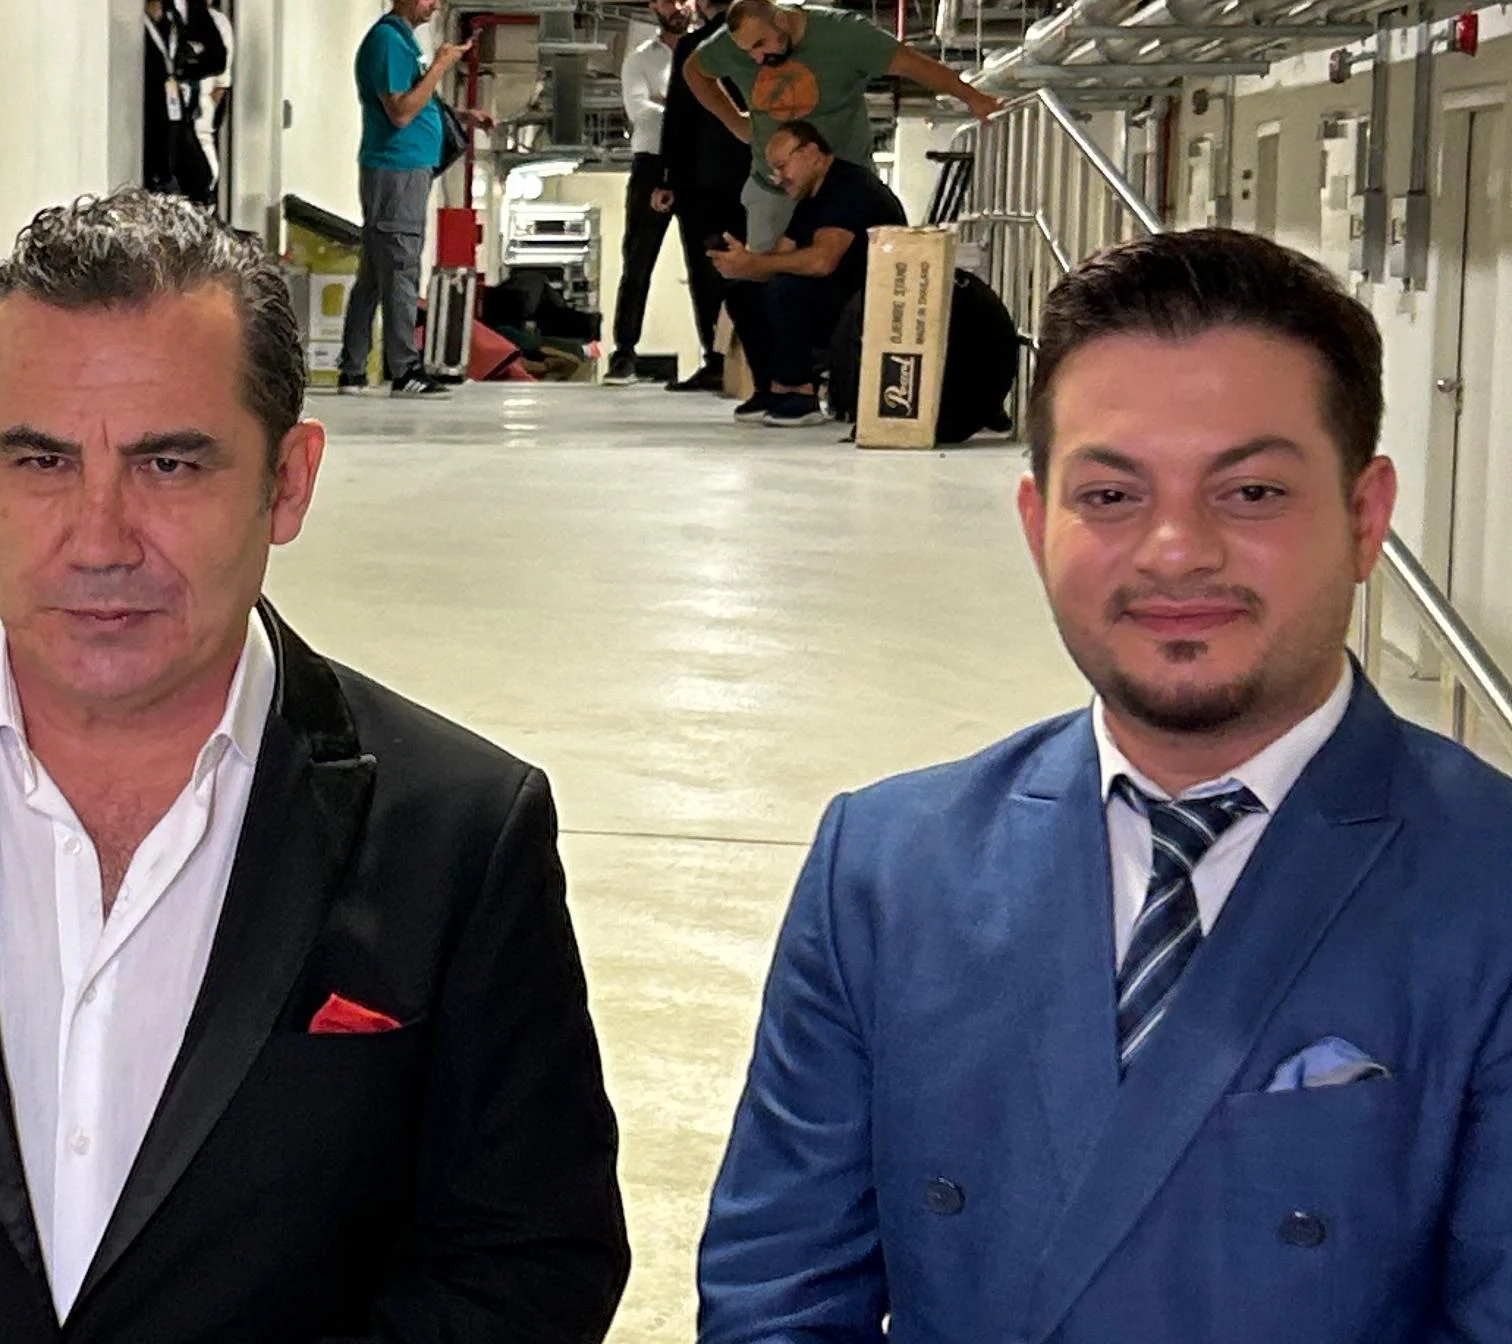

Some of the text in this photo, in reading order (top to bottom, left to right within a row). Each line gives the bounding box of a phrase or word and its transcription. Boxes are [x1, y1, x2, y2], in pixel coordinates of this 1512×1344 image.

[894, 262, 907, 296] STAND
[916, 319, 926, 344] MADE
[884, 355, 915, 416] Pearl
